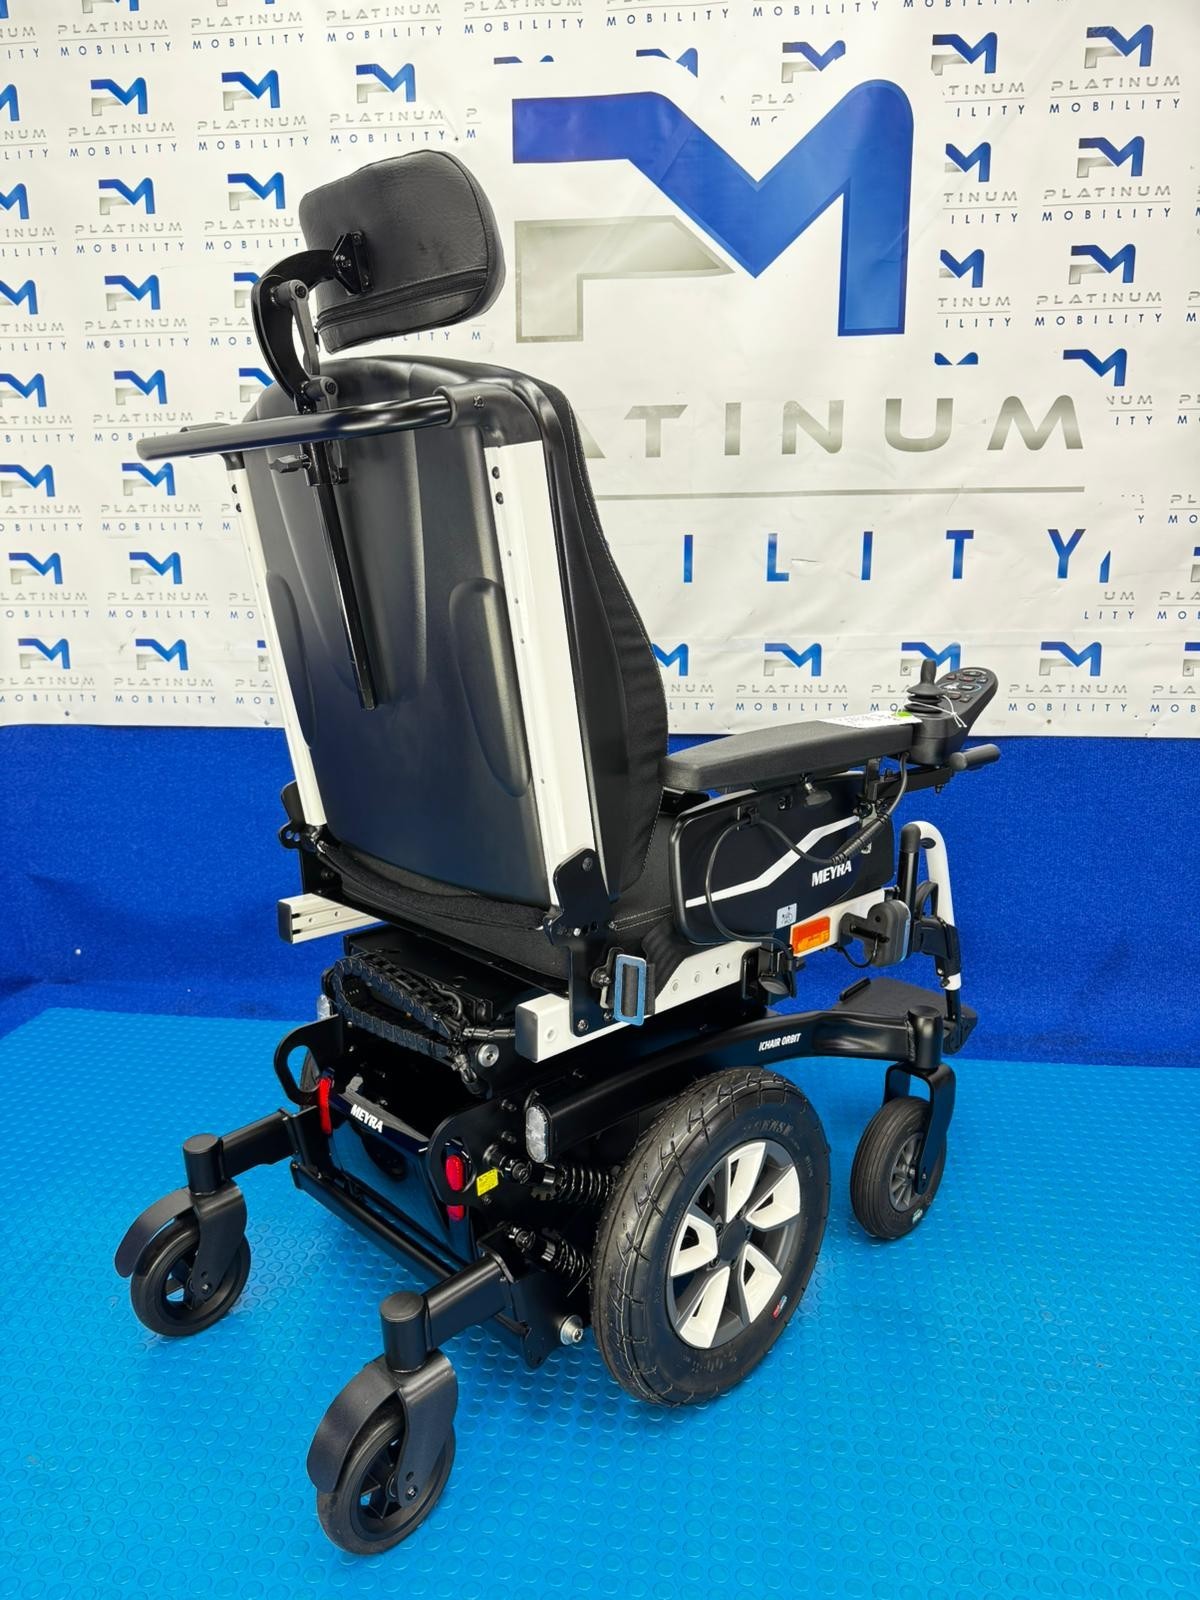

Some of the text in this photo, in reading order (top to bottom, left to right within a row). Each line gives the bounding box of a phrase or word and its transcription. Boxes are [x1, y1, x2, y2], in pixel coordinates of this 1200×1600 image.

[326, 3, 441, 21] PLATINUM
[752, 1, 878, 17] MOBILITY
[191, 11, 302, 28] PLATINUM
[606, 9, 729, 27] MOBILITY
[57, 19, 168, 34] PLATINUM
[464, 19, 583, 34] MOBILITY
[192, 33, 305, 49] MOBILITY
[327, 26, 442, 42] MOBILITY
[60, 41, 172, 57] MOBILITY
[1051, 75, 1180, 91] PLATINUM
[1049, 98, 1180, 113] MOBILITY
[197, 115, 307, 130] PLATINUM
[329, 109, 444, 123] PLATINUM
[68, 122, 175, 137] PLATINUM
[198, 136, 311, 151] MOBILITY
[330, 130, 445, 144] MOBILITY
[69, 143, 178, 158] MOBILITY
[1044, 185, 1171, 200] PLATINUM
[1042, 207, 1171, 222] MOBILITY
[75, 222, 183, 234] PLATINUM
[204, 217, 300, 230] PLATINU
[76, 242, 184, 254] MOBILITY
[1036, 291, 1162, 305] PLATINUM
[84, 317, 188, 330] PLATINUM
[1035, 313, 1162, 327] MOBILITY
[93, 412, 193, 423] PLATINUM
[100, 503, 201, 514] PLATINUM
[102, 522, 204, 532] MOBILITY
[107, 592, 209, 602] PLATINUM
[108, 609, 211, 619] MOBILITY
[114, 677, 214, 688] PLATINUM
[736, 684, 848, 694] PLATINUM
[1009, 684, 1128, 694] PLATINUM
[115, 694, 216, 704] MOBILITY
[736, 702, 849, 712] MOBILITY
[1008, 702, 1128, 712] MOBILITY
[811, 860, 852, 887] MEYRA
[781, 1032, 802, 1046] ORBIT
[350, 1103, 384, 1133] MEYRA
